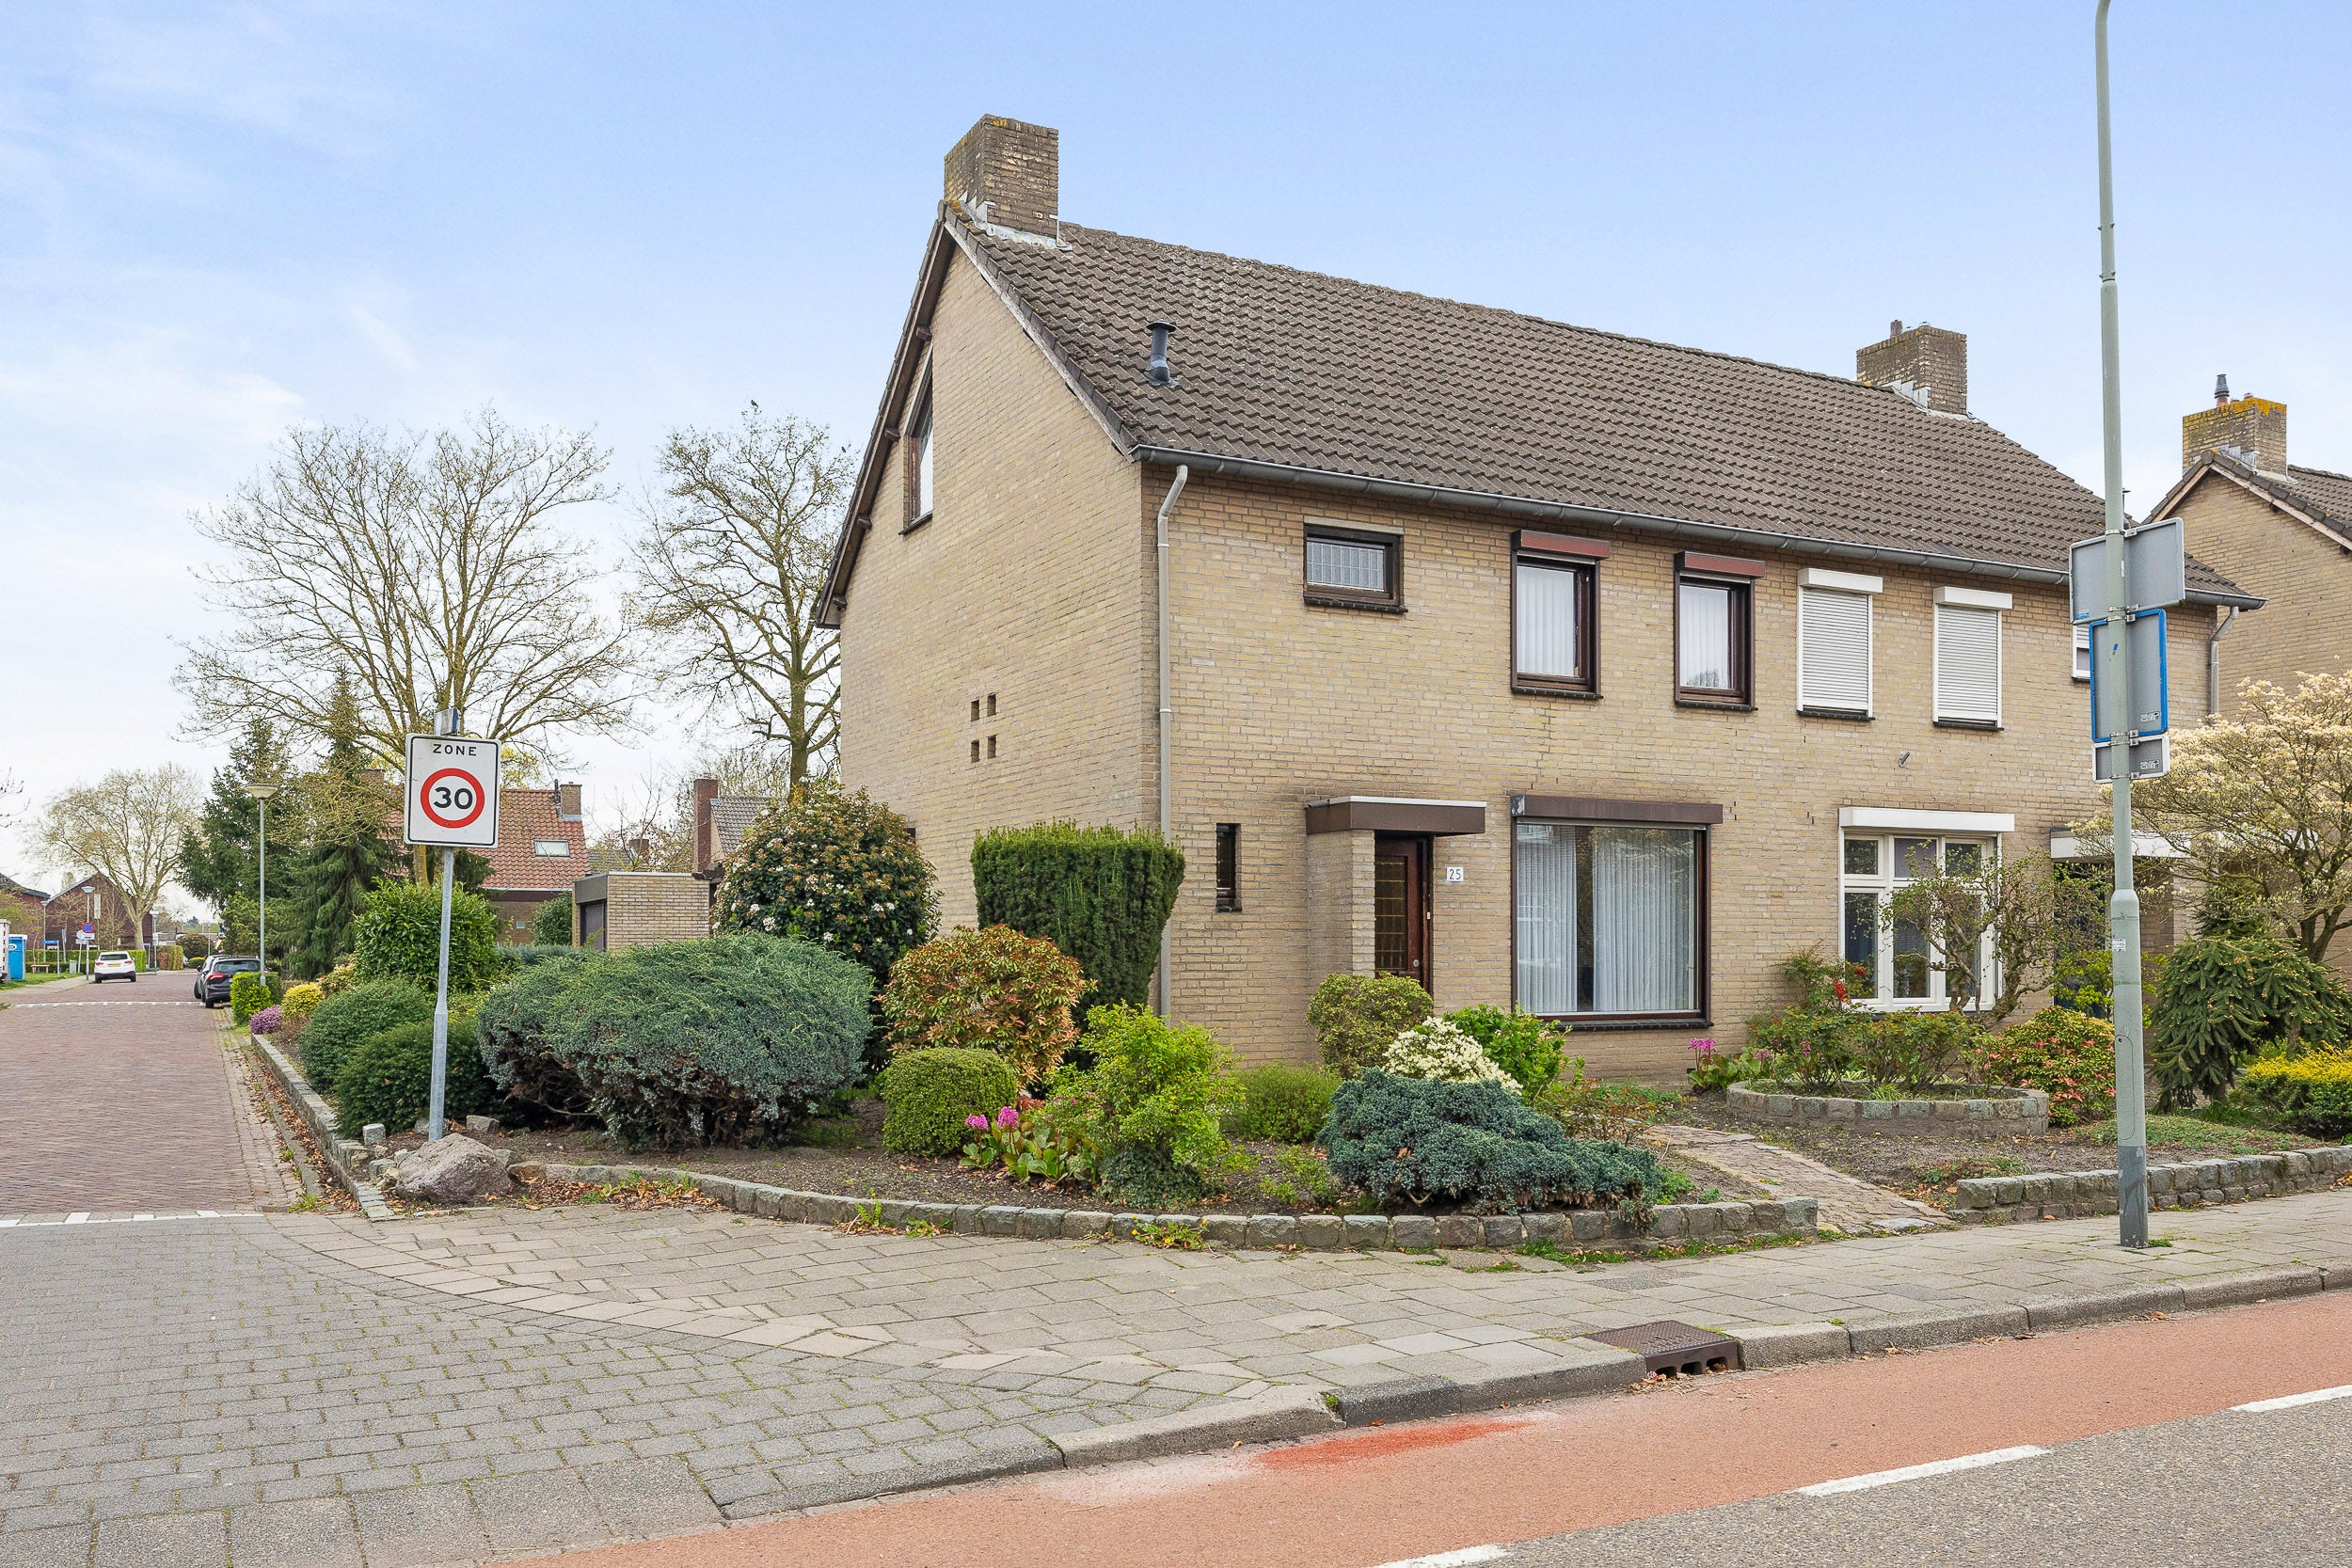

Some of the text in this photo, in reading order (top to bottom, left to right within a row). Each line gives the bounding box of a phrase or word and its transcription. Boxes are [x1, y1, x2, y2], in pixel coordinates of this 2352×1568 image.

[432, 743, 477, 756] ZONE
[433, 786, 473, 810] 30
[1449, 868, 1462, 880] 25
